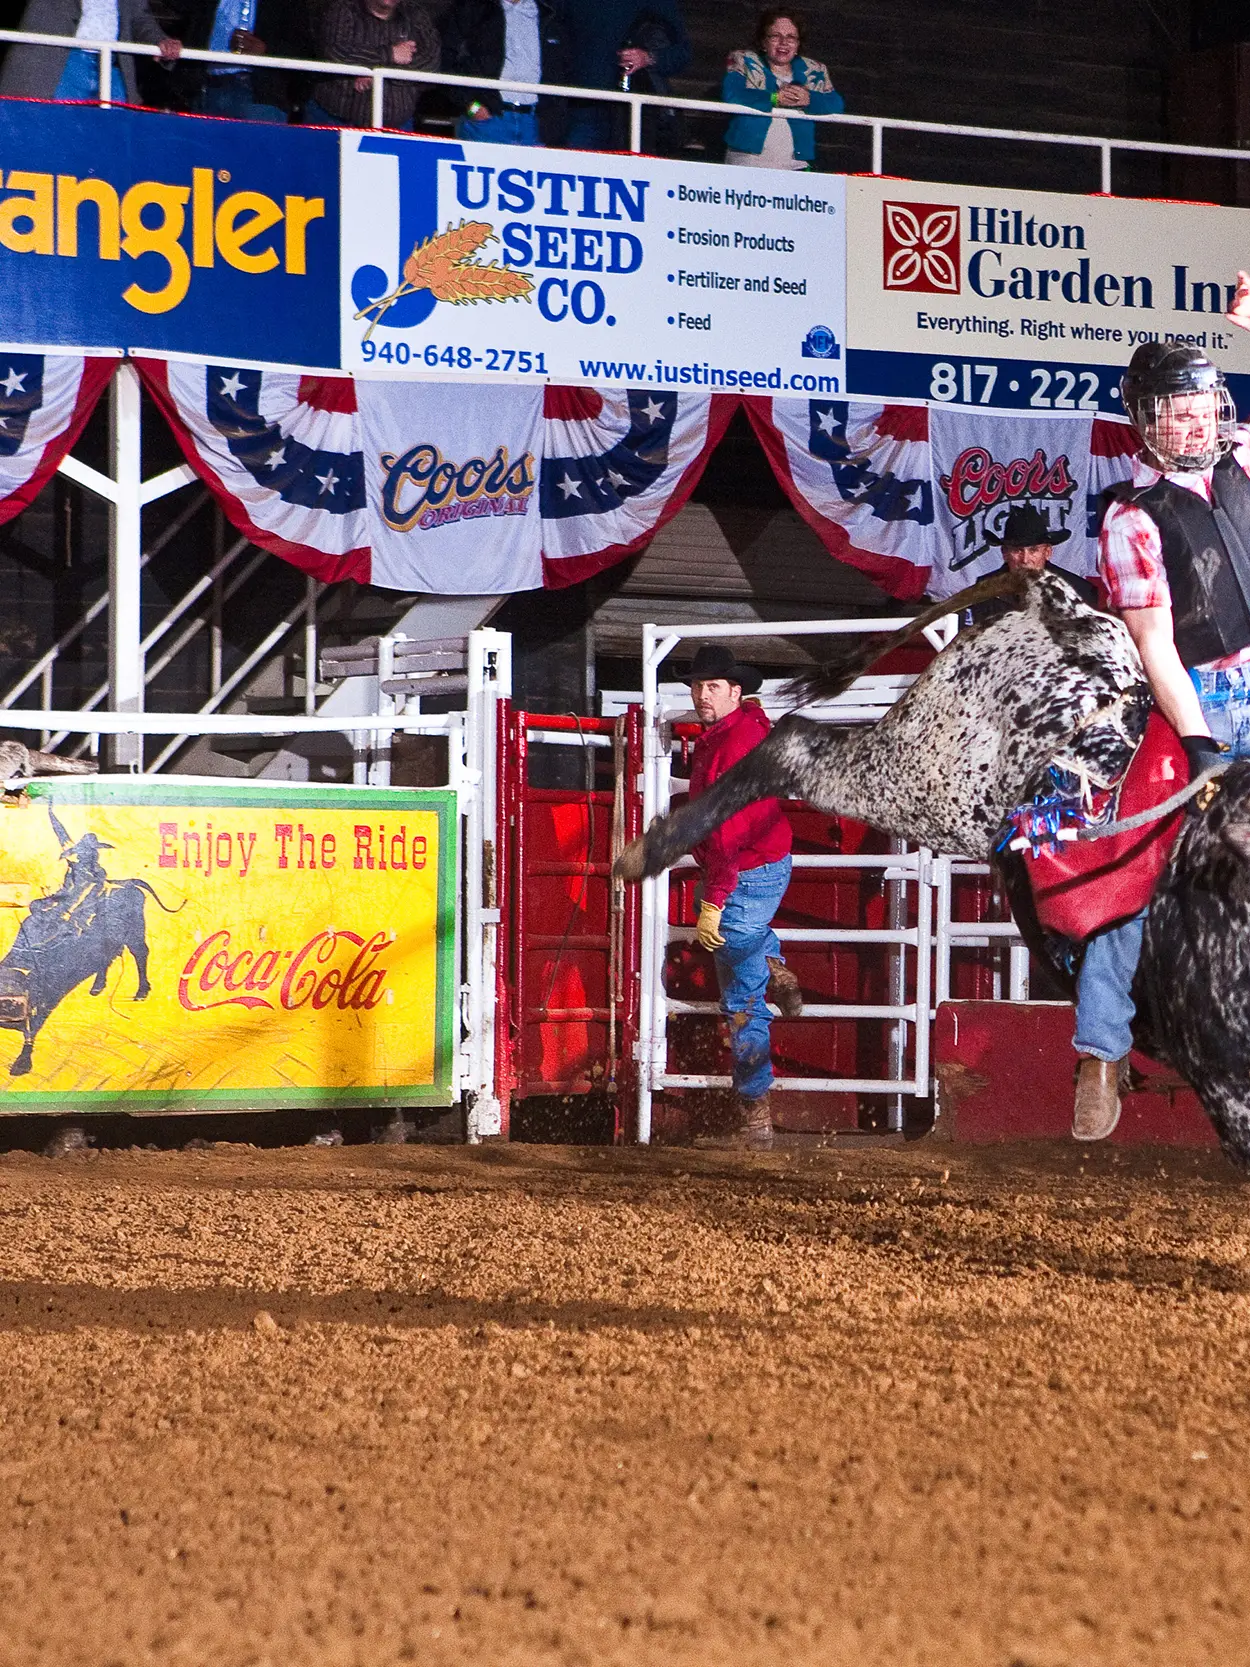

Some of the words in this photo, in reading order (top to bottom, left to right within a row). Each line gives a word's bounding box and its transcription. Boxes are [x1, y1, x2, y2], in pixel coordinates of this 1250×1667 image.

[678, 184, 722, 205] Bowie
[0, 167, 325, 314] angler
[351, 135, 651, 329] JUSTIN
[502, 221, 644, 274] SEED
[678, 227, 730, 248] Erosion
[733, 231, 795, 253] Products
[967, 205, 1087, 249] Hilton
[537, 277, 617, 327] CO.
[678, 269, 741, 291] Fertilizer
[743, 276, 770, 293] and
[773, 277, 807, 296] Seed
[967, 248, 1154, 309] Garden
[678, 312, 712, 331] Feed
[916, 311, 1014, 338] Everything.
[1020, 317, 1066, 339] Right
[1070, 322, 1123, 342] where
[1128, 330, 1159, 347] you
[1164, 331, 1207, 348] need
[361, 339, 549, 375] 940-648-2751
[929, 362, 998, 404] 817
[1029, 368, 1100, 411] 222
[381, 443, 535, 532] Coors
[940, 446, 1078, 519] Coors
[418, 497, 530, 530] ORIGINAL
[158, 822, 258, 878] Enjoy
[274, 824, 337, 869] The
[353, 825, 428, 870] Ride
